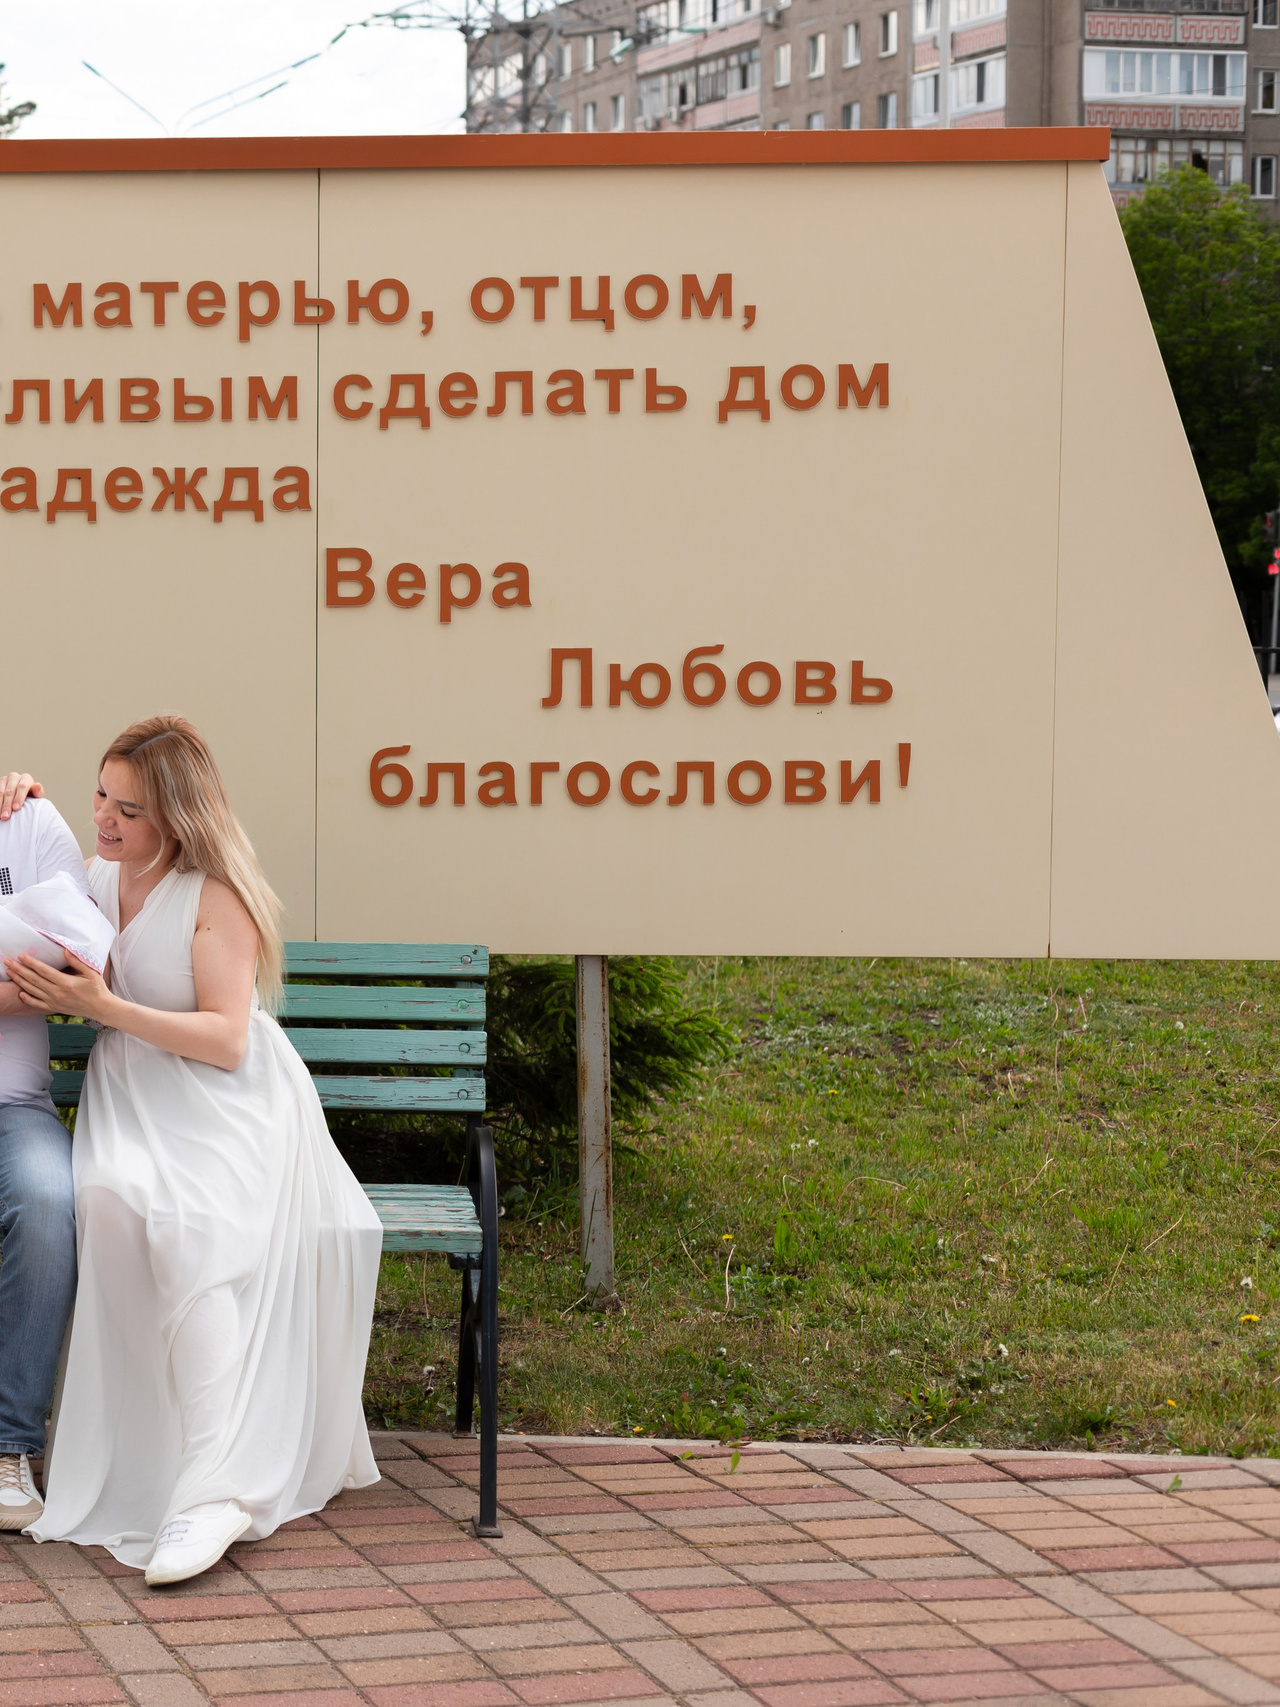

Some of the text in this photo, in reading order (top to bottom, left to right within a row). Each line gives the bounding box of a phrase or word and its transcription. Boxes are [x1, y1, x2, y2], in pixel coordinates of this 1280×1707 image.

[32, 278, 434, 343] матерью,
[469, 273, 757, 332] отцом,
[332, 367, 688, 431] сделать
[717, 362, 890, 424] дом
[325, 547, 532, 623] Вера
[541, 643, 894, 709] Любовь
